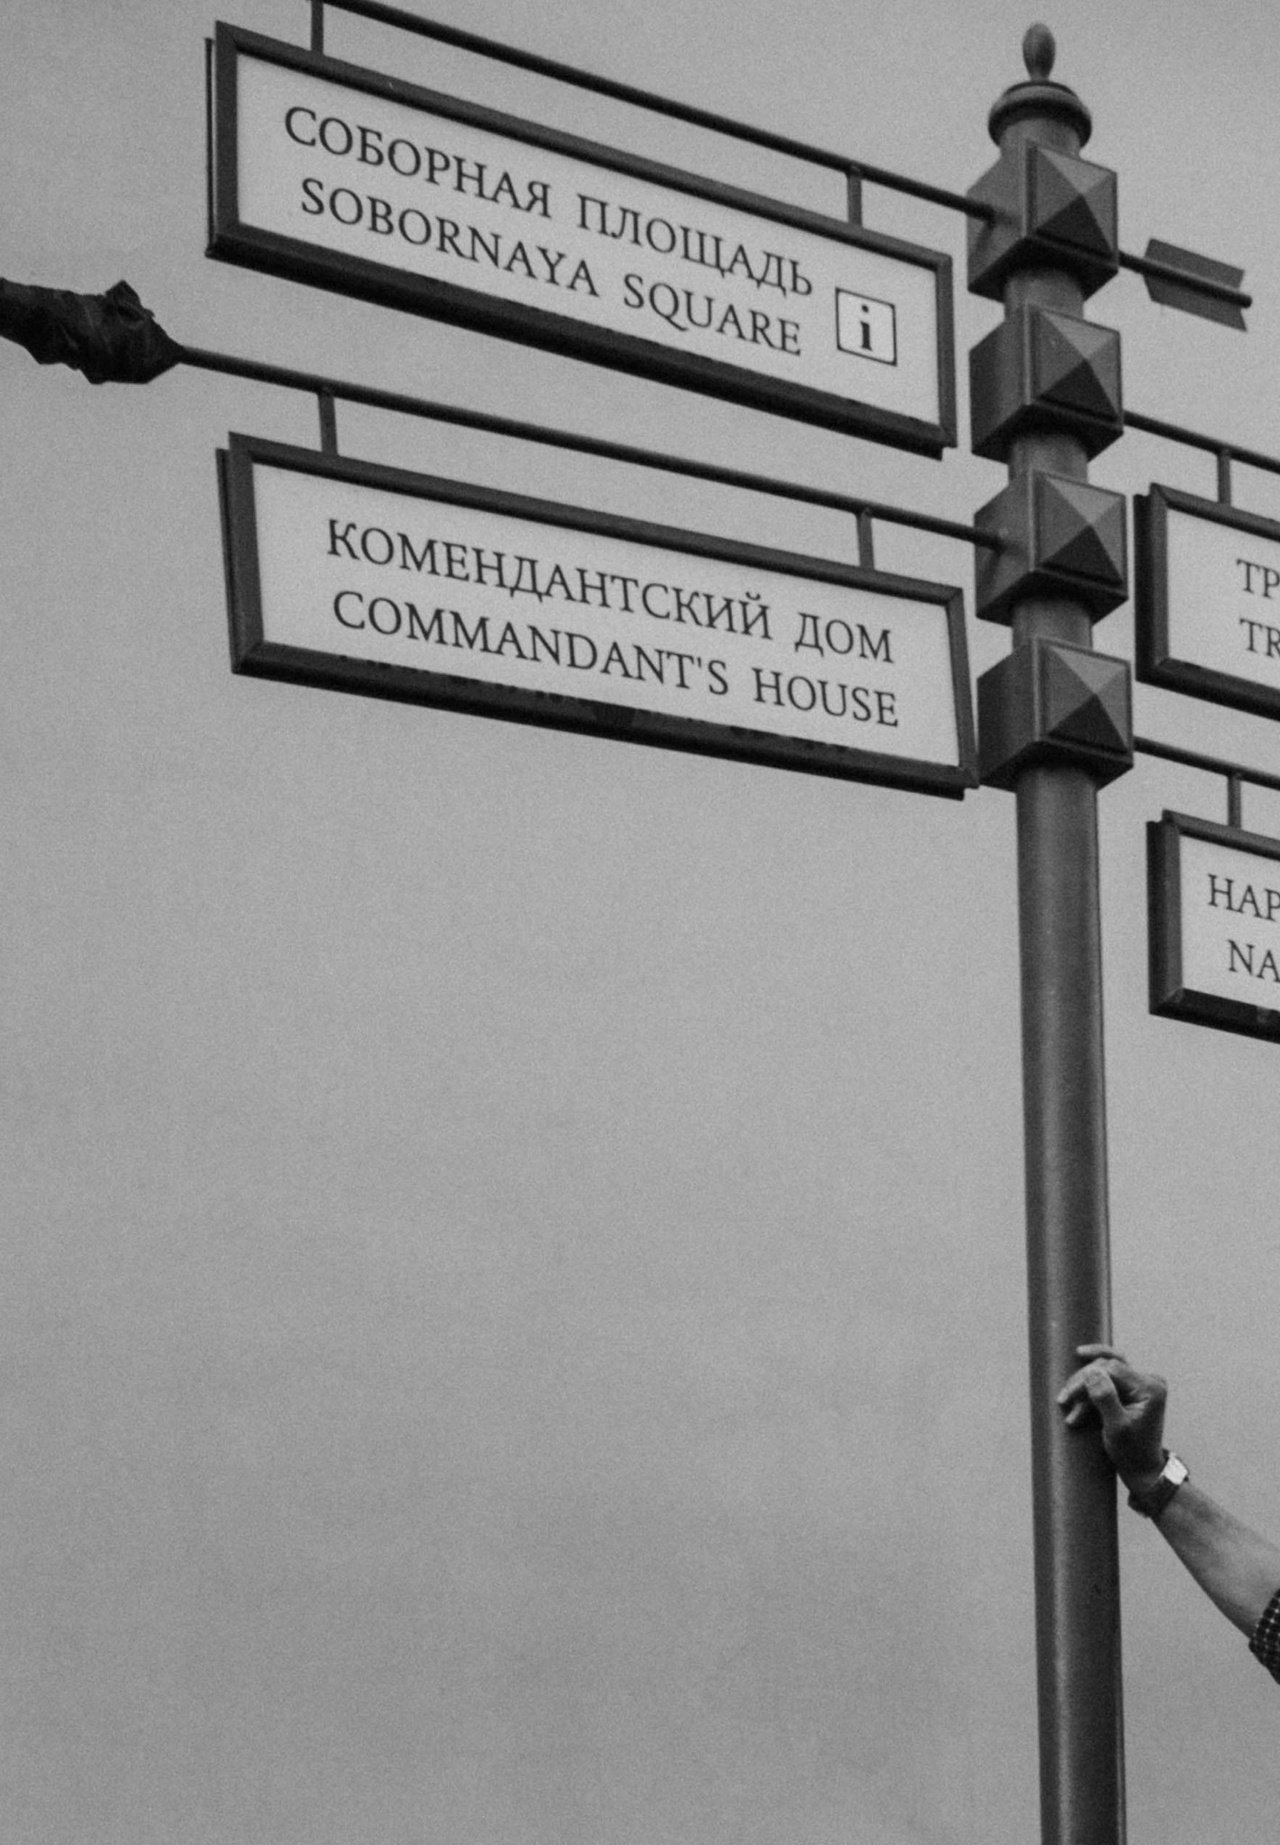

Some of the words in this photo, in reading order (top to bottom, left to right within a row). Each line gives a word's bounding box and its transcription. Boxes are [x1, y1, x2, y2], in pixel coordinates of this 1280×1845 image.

[284, 106, 552, 217] СОБОРНАЯ
[577, 193, 812, 296] ПЛОЩАДЬ
[301, 179, 598, 295] SOBORNAYA
[623, 274, 801, 354] SQUARE
[327, 519, 772, 638] КОМЕНДАНТСКИЙ
[794, 612, 894, 662] ДОМ
[333, 592, 729, 695] COMMANDANT'S
[753, 668, 898, 726] HOUSE
